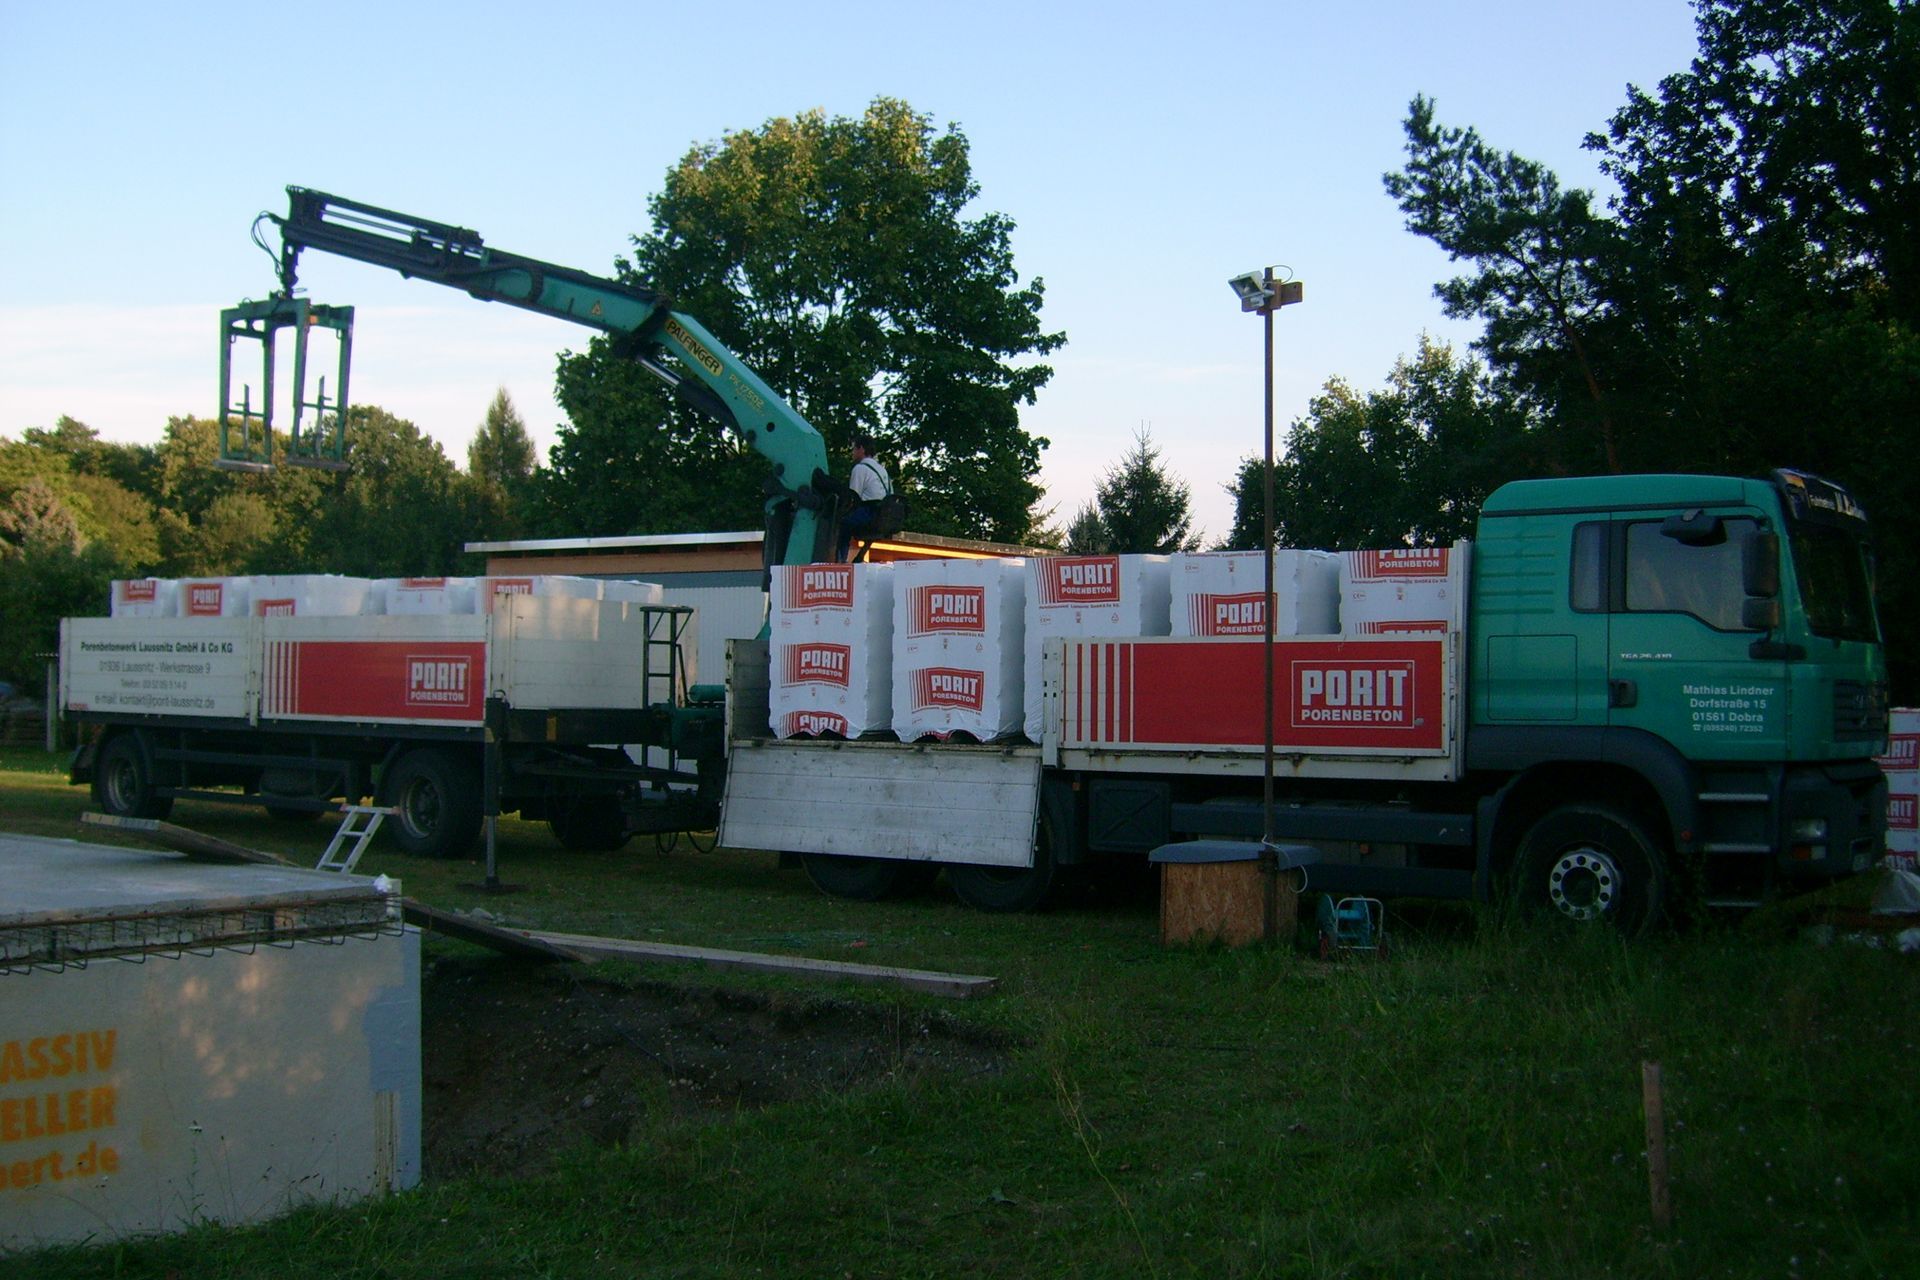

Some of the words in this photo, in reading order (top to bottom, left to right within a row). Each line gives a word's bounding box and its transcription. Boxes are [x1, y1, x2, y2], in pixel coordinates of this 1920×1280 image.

[667, 321, 720, 373] PALFINGER
[1379, 560, 1440, 569] PORENBETON
[803, 571, 849, 590] PORIT
[1060, 564, 1113, 585] PORIT
[193, 589, 219, 604] PORIT
[803, 591, 848, 600] PORENBETON
[1061, 586, 1112, 594] PORENBETON
[931, 594, 979, 615] PORIT
[931, 616, 978, 624] PORENBETON
[81, 641, 136, 652] Porenbetonwerk
[139, 642, 173, 652] Laussnitz
[175, 642, 198, 652] GmbH
[208, 643, 218, 653] Co
[221, 643, 233, 653] KG
[801, 650, 845, 670] PORIT
[410, 662, 467, 690] PORIT
[801, 668, 843, 678] PORENBETON
[931, 675, 978, 696] PORIT
[1301, 669, 1408, 706] PORIT
[1683, 685, 1727, 695] Mathias
[1730, 685, 1774, 695] Lindner
[411, 691, 464, 701] PORENBETON
[932, 693, 976, 703] PORENBETON
[1690, 698, 1750, 709] Dorfstraße
[1754, 699, 1767, 709] 15
[1301, 709, 1403, 722] PORENBETON
[1692, 712, 1725, 722] 01561
[1729, 712, 1764, 722] Dobra
[800, 714, 843, 735] PORIT
[1888, 739, 1917, 758] RIT
[1887, 800, 1913, 817] RIT
[0, 1029, 117, 1084] ASSIV
[0, 1086, 118, 1143] ELLER
